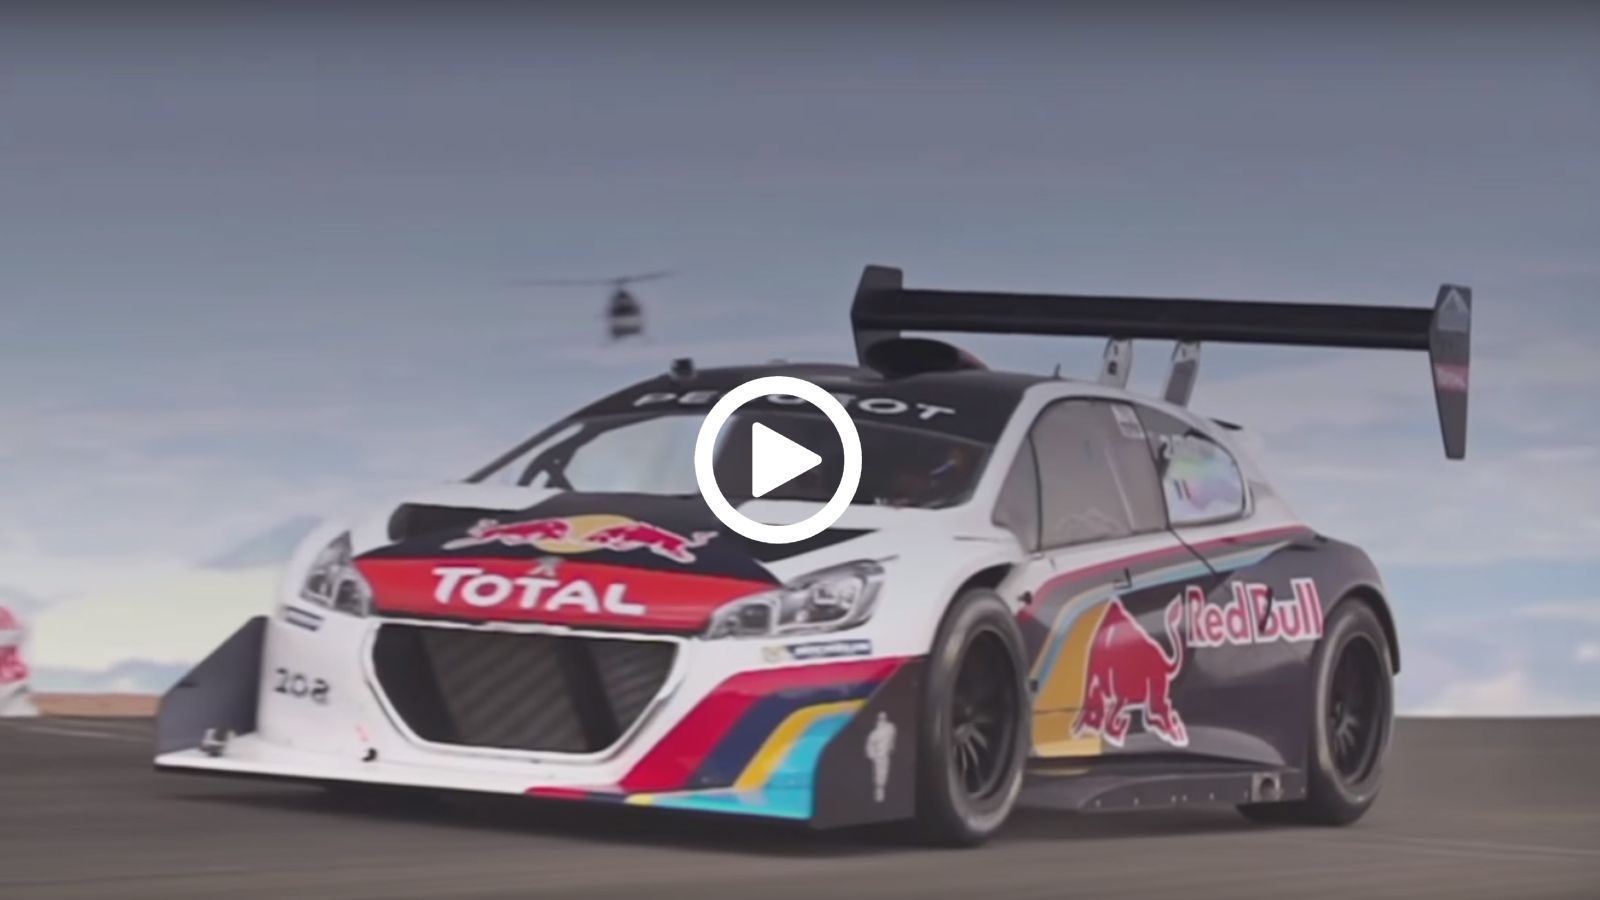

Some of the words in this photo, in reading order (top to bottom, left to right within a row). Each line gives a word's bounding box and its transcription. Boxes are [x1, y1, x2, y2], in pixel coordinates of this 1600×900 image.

[431, 566, 647, 616] TOTAL
[1186, 580, 1251, 647] Red
[1246, 577, 1323, 642] Bull
[274, 668, 331, 706] 208
